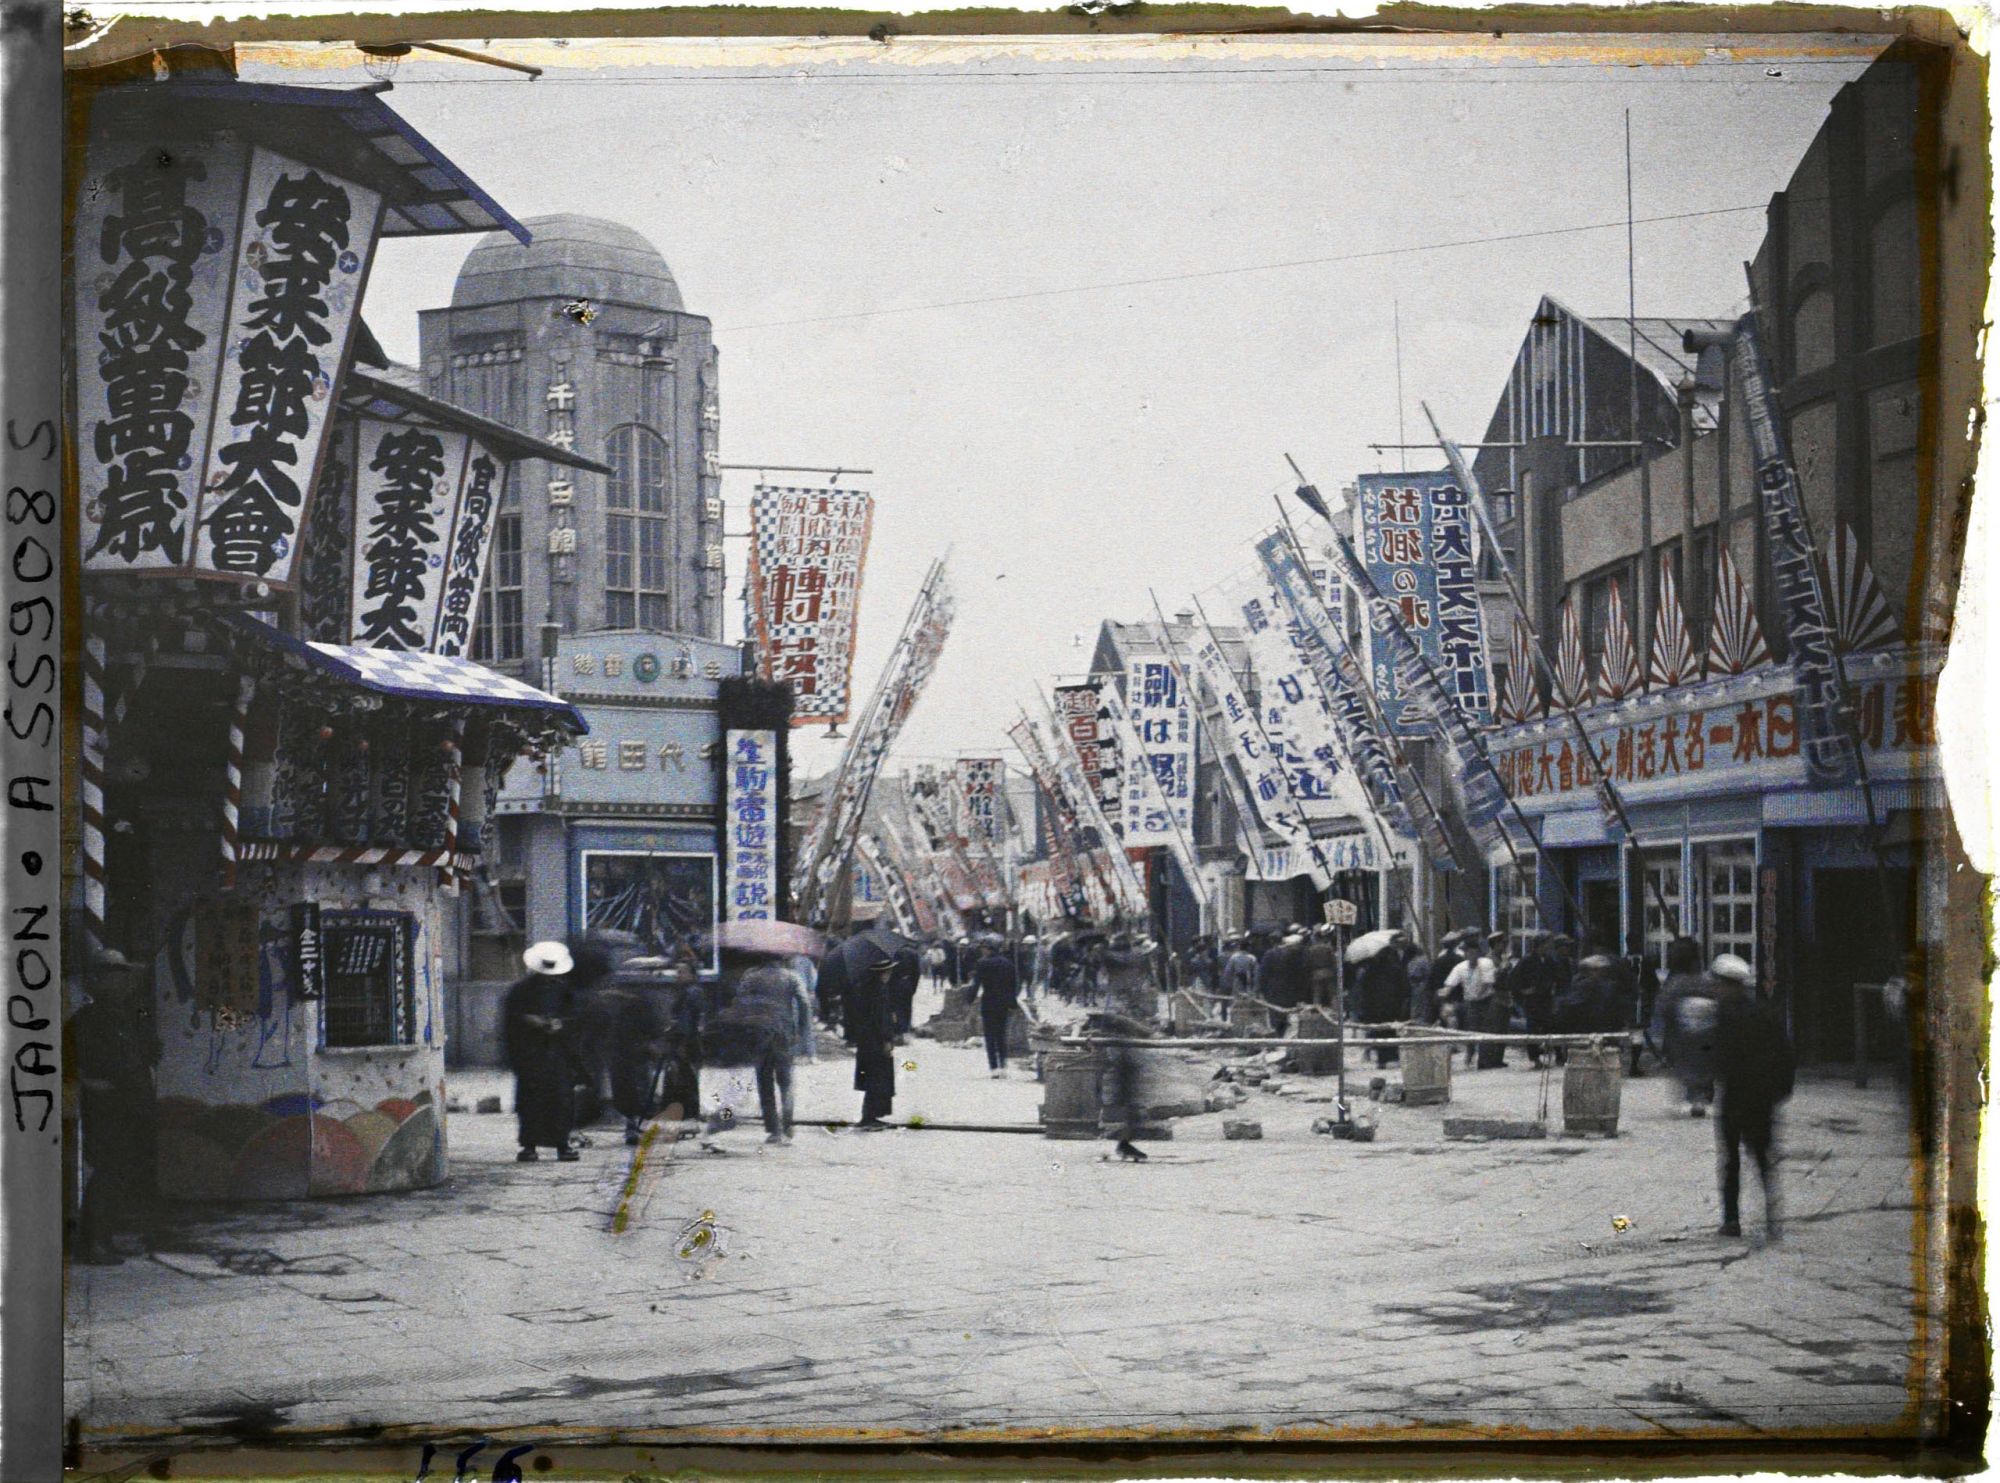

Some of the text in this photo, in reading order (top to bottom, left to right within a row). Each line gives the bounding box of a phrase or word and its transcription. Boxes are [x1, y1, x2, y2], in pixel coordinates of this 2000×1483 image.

[6, 416, 54, 460] S
[8, 775, 54, 812] A
[6, 903, 55, 1133] JAPON
